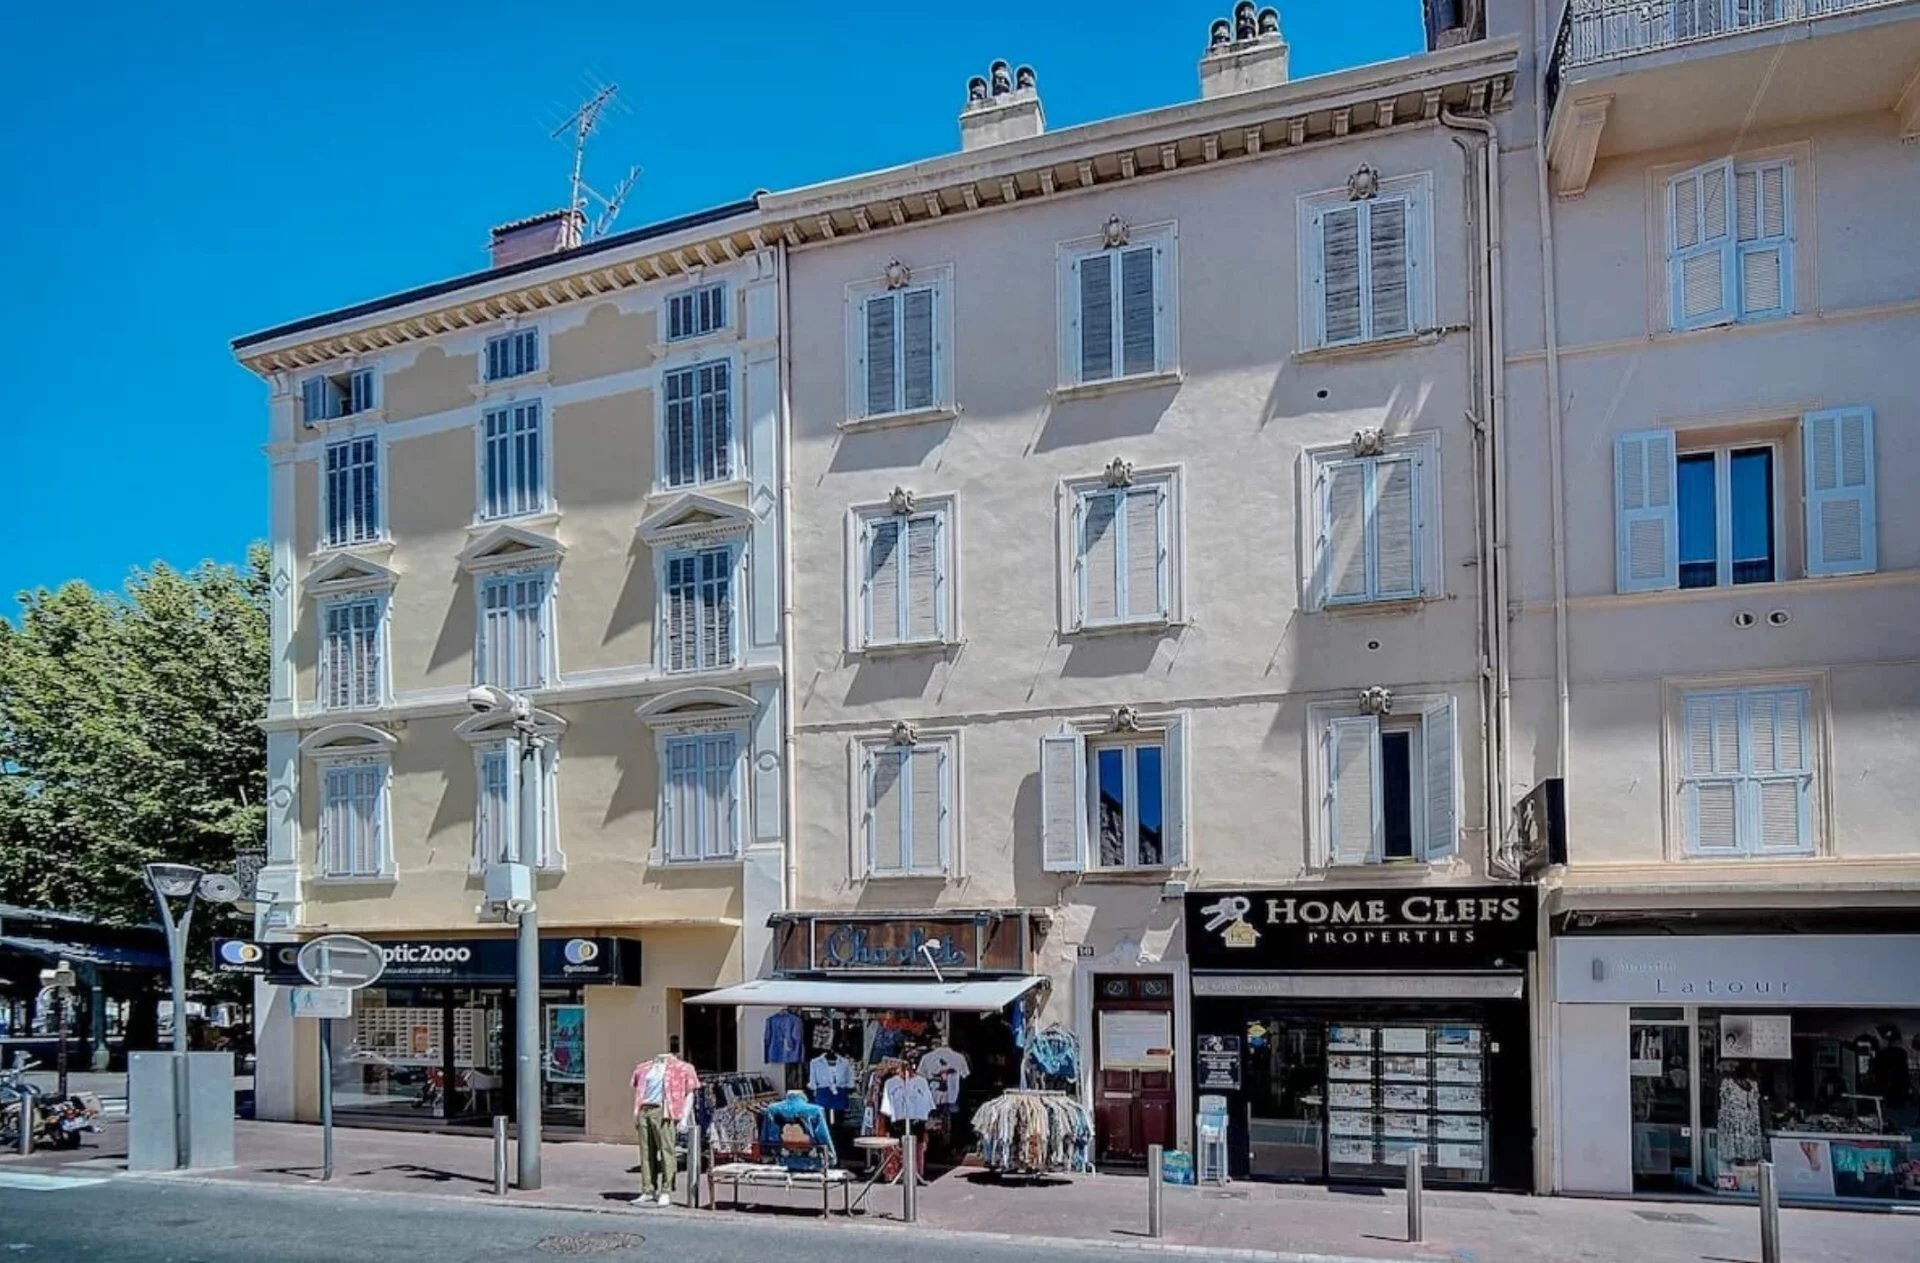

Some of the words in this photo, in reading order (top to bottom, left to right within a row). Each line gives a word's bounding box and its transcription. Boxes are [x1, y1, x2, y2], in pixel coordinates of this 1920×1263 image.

[1266, 899, 1389, 923] HOME
[1401, 896, 1520, 922] CLEFS
[1308, 931, 1475, 943] PROPERTIES
[1656, 978, 1791, 993] Latour
